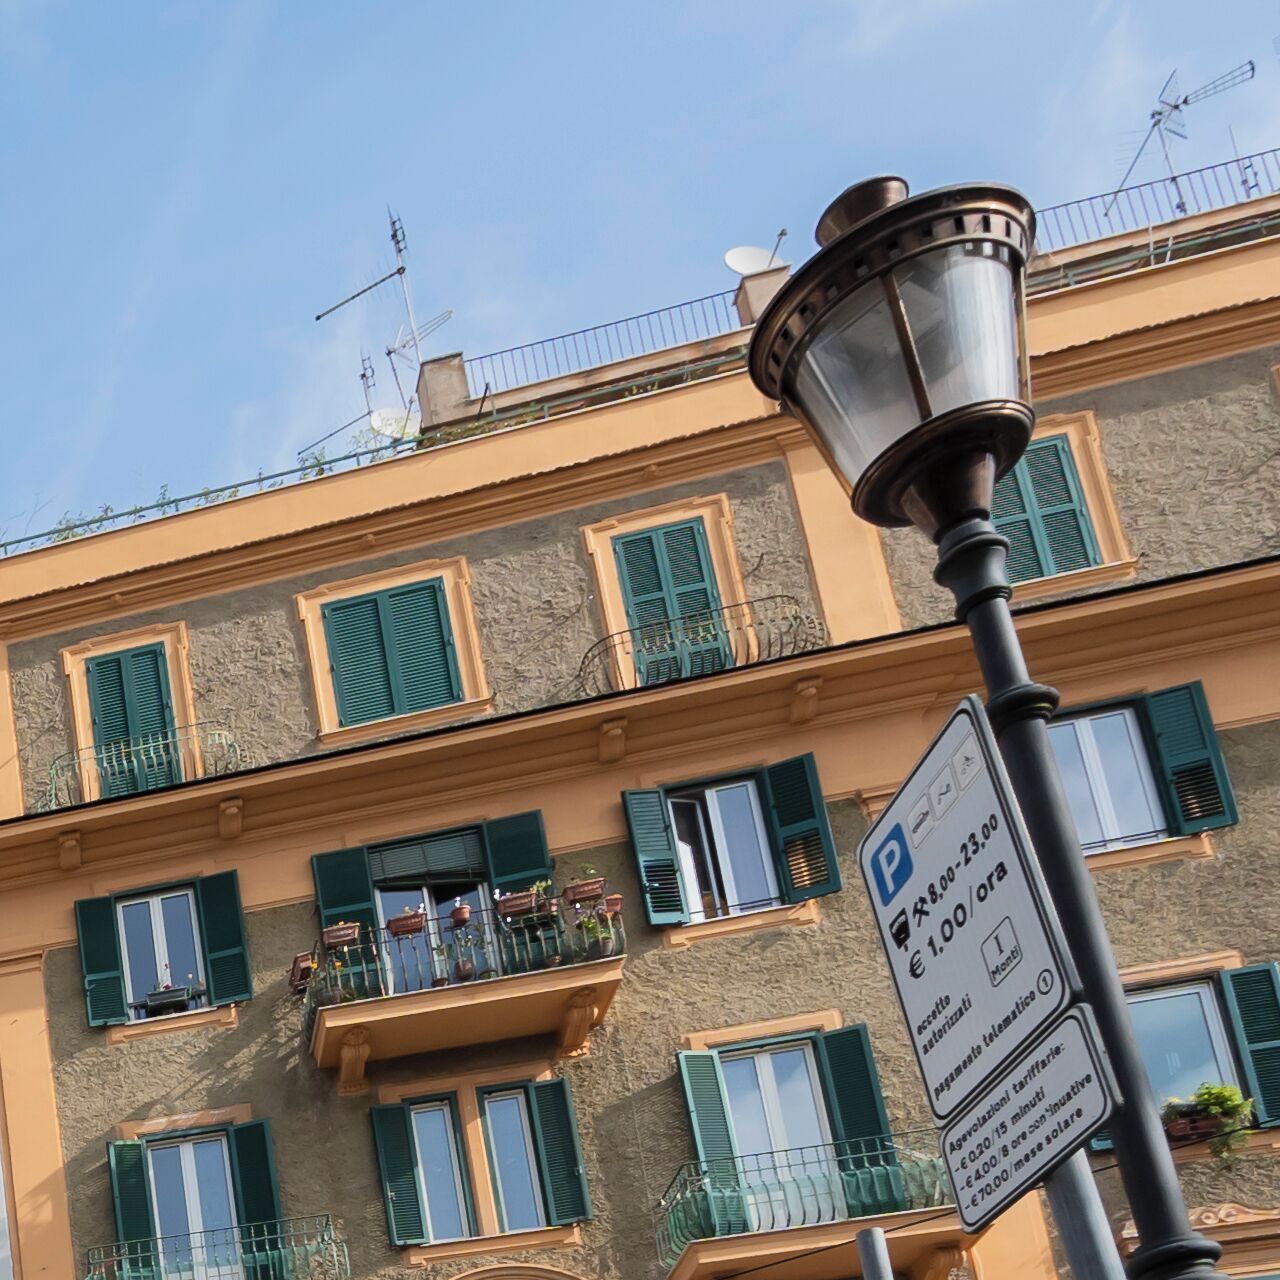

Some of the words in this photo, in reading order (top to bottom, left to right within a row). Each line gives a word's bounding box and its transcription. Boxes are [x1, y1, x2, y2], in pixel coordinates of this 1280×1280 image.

[878, 839, 901, 895] P
[909, 949, 926, 979] €
[991, 945, 1020, 982] Monti
[916, 994, 951, 1036] eccetto
[921, 993, 973, 1056] autorizzati
[933, 1044, 983, 1101] pagamento
[982, 989, 1036, 1048] telematico
[948, 1089, 1011, 1155] Agevolazioni
[1011, 1042, 1066, 1095] tariffarie:
[1009, 1086, 1046, 1126] minuti
[1010, 1129, 1028, 1150] ore
[1044, 1107, 1084, 1146] solare
